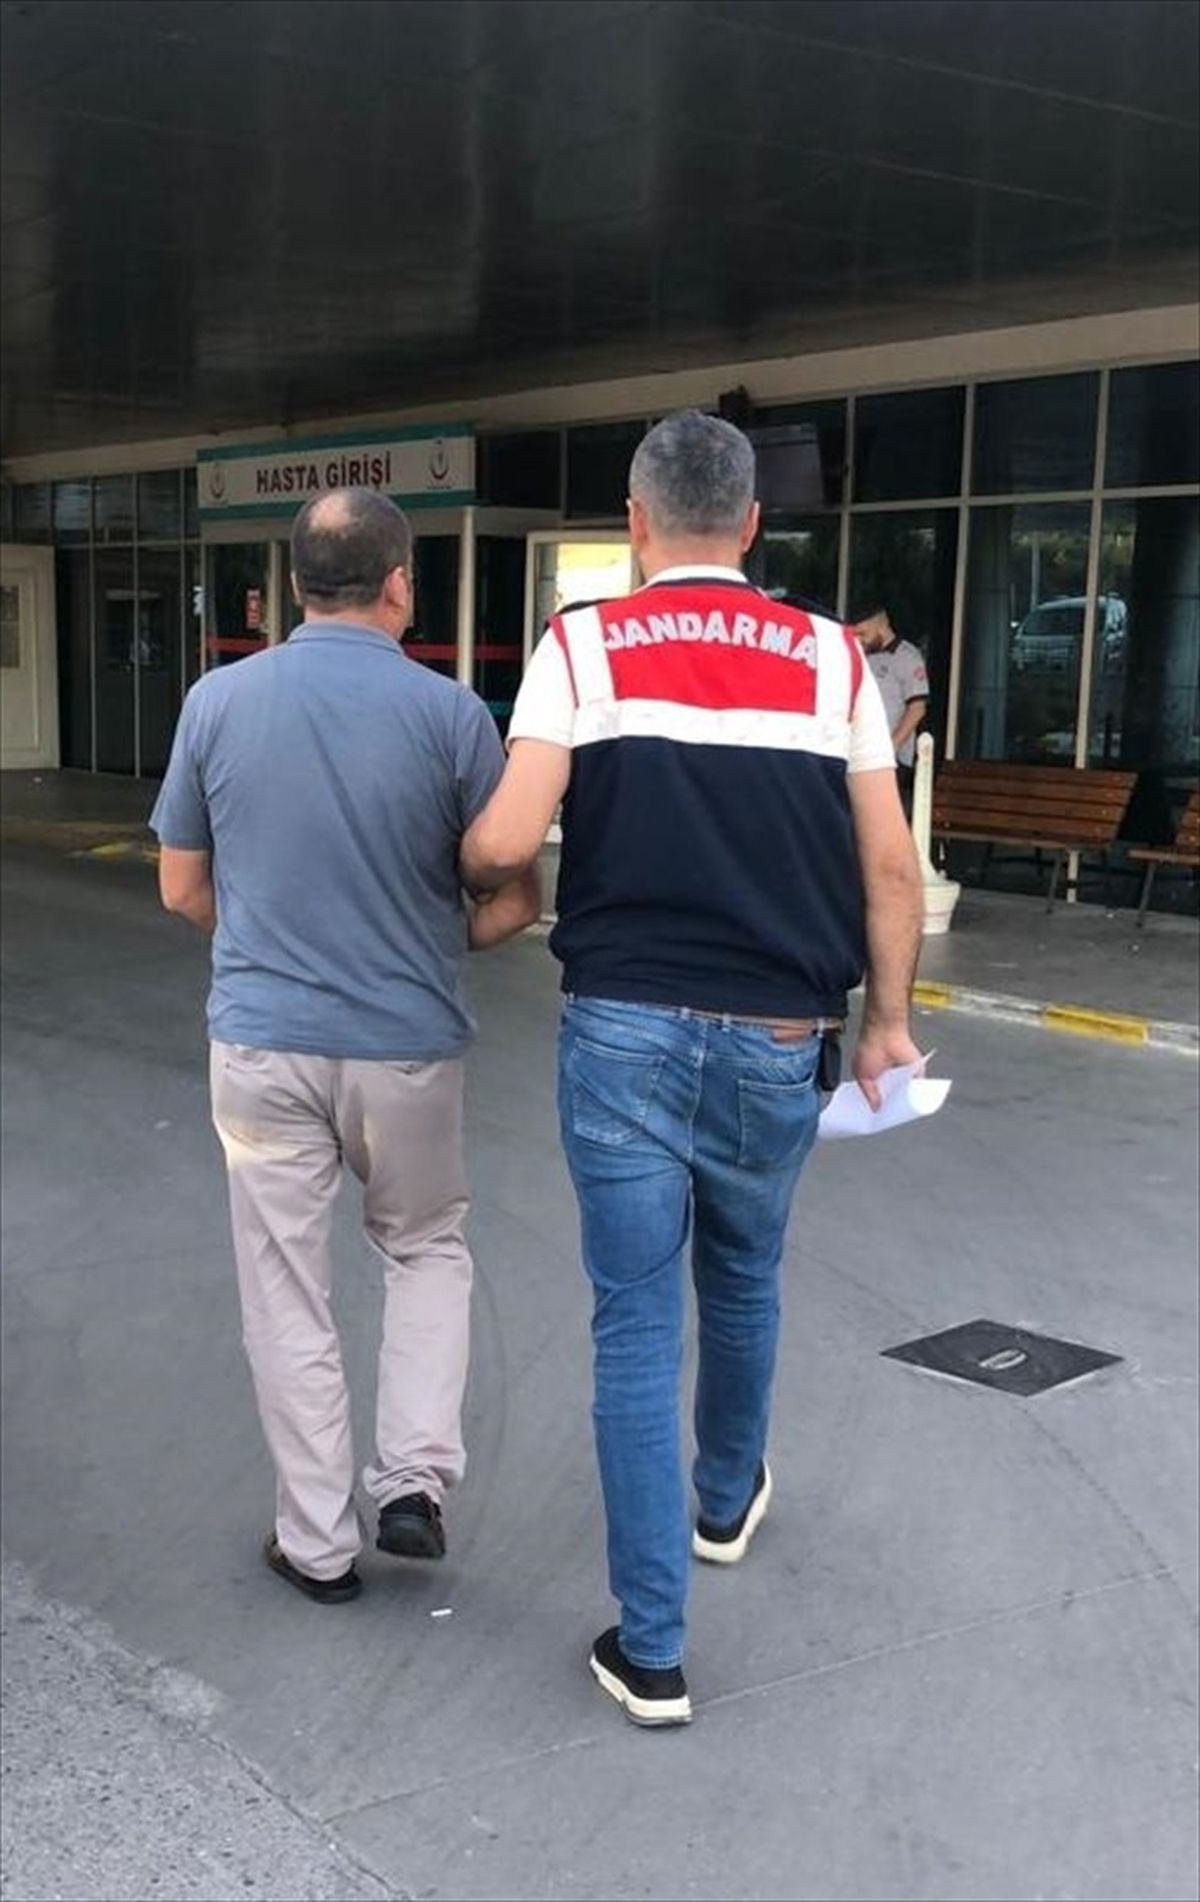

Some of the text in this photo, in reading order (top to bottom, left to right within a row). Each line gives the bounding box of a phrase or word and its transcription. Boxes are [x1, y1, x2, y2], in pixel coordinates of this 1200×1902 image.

[256, 451, 391, 493] HASTA GİRİŞİ
[604, 611, 817, 670] JANDARMA
